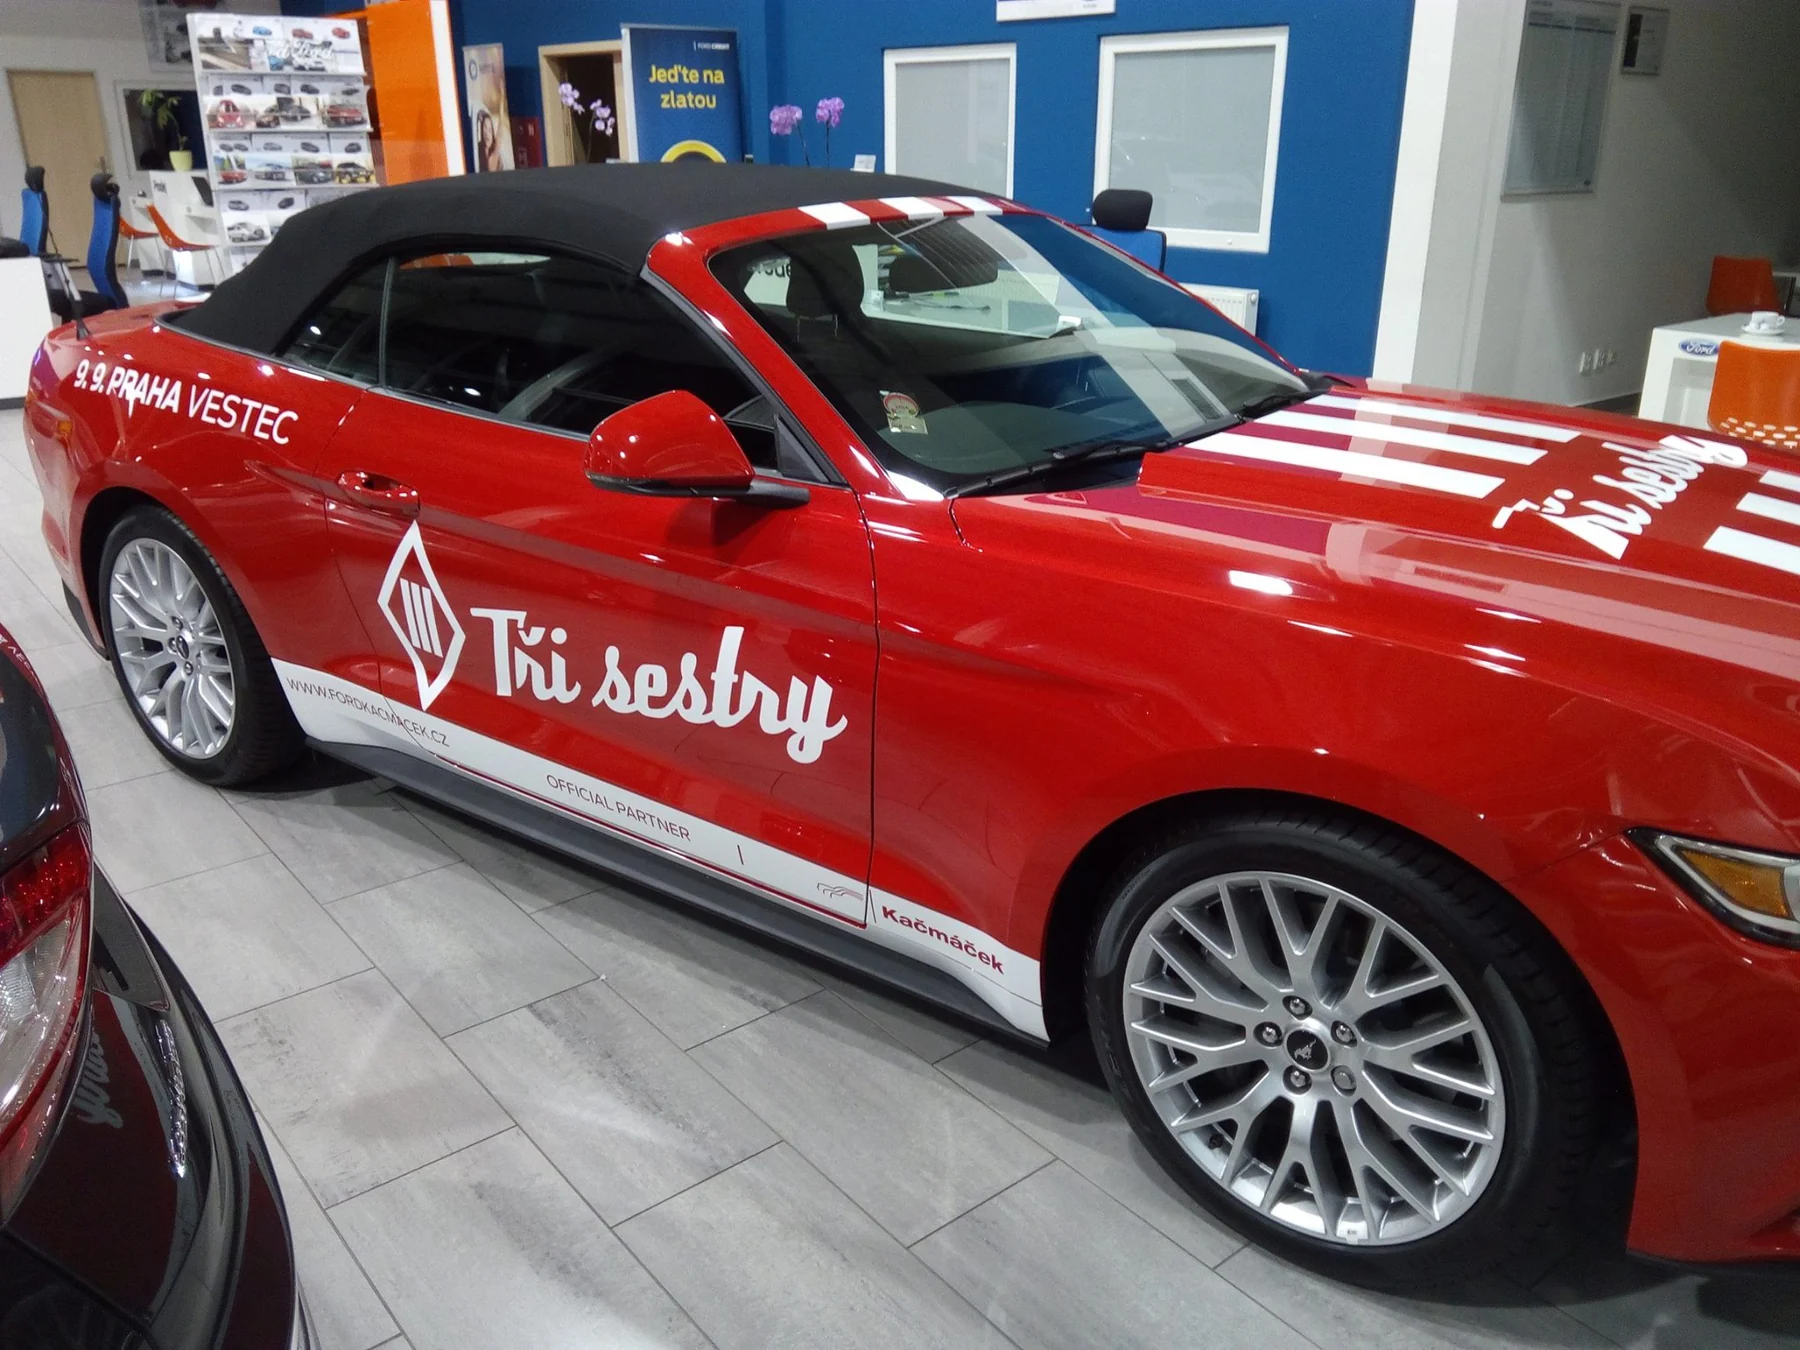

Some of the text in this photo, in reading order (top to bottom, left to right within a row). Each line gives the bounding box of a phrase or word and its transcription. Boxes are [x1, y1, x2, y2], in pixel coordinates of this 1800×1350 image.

[660, 90, 717, 108] zlatou
[703, 69, 725, 84] na
[1684, 341, 1716, 355] Ford
[105, 366, 182, 419] PRAHA
[188, 384, 299, 445] VESTEC
[286, 677, 450, 747] WWW.FORDKACMACEK.CZ
[592, 625, 848, 764] sestry
[546, 774, 691, 842] OFFICIAL PARTNER
[882, 905, 1004, 974] Kačmáček
